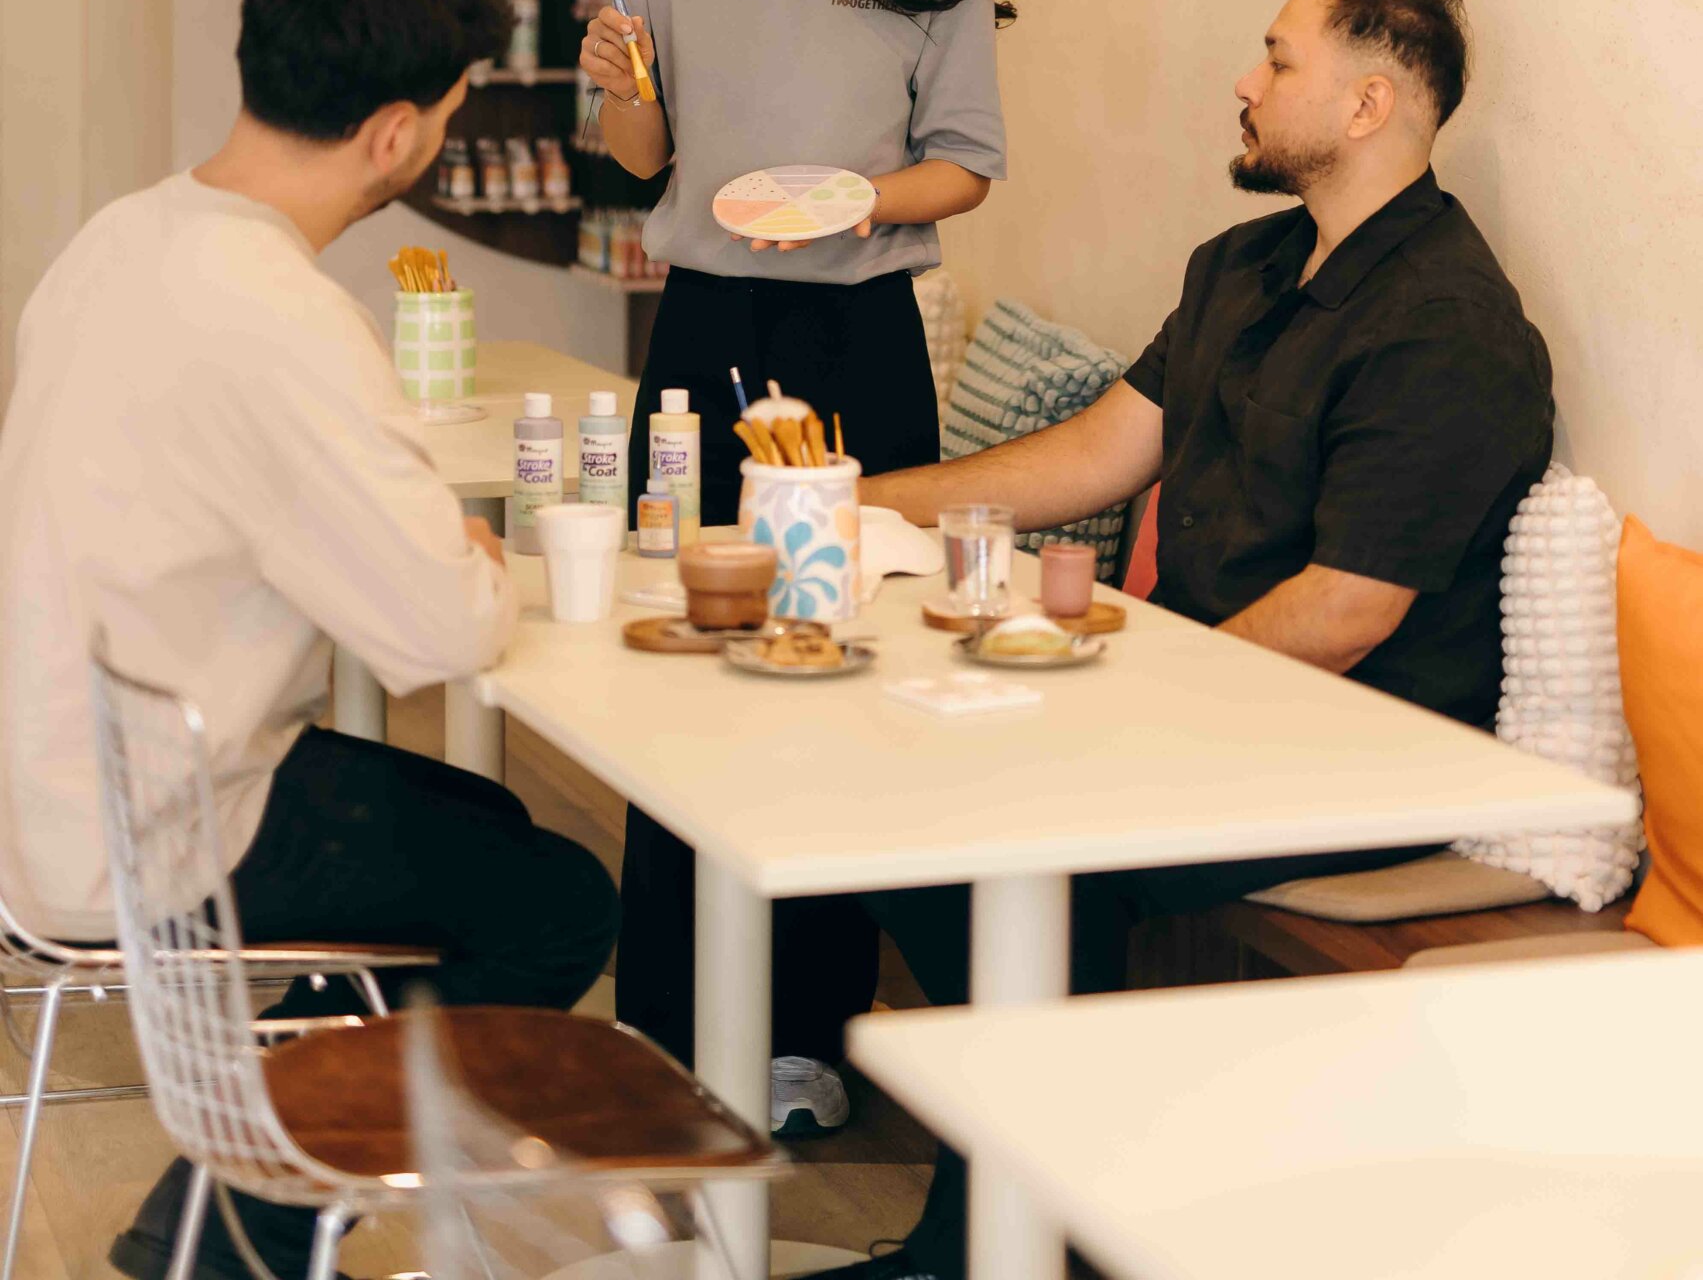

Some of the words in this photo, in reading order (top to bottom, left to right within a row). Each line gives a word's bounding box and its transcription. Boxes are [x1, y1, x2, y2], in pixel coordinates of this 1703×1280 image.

[583, 453, 616, 466] Stroke
[654, 450, 687, 464] roke
[518, 459, 552, 472] Stroke
[588, 465, 617, 477] Coat
[524, 472, 553, 484] Coat
